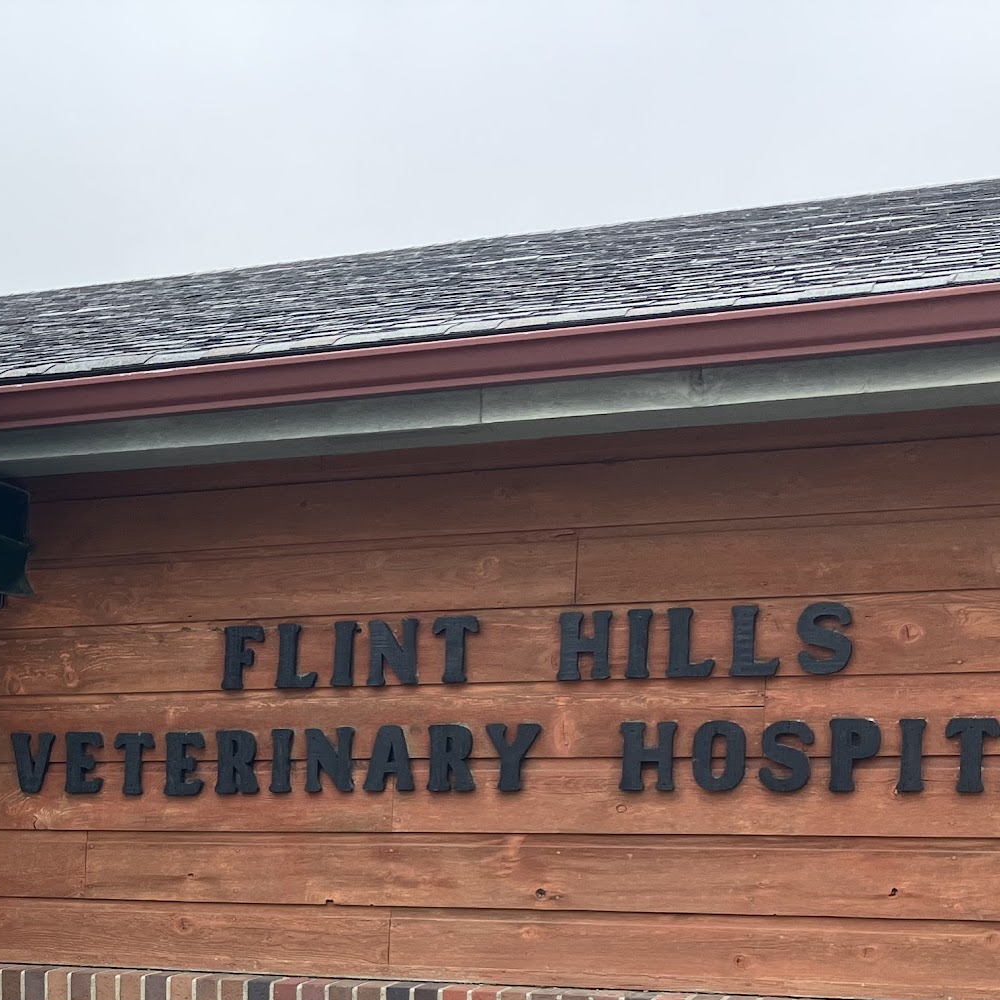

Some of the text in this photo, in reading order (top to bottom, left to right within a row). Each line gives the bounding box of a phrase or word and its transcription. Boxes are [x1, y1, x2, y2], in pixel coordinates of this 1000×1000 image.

[221, 601, 853, 690] FLINT HILLS
[10, 716, 1000, 797] VETERINARY HOSPIT
